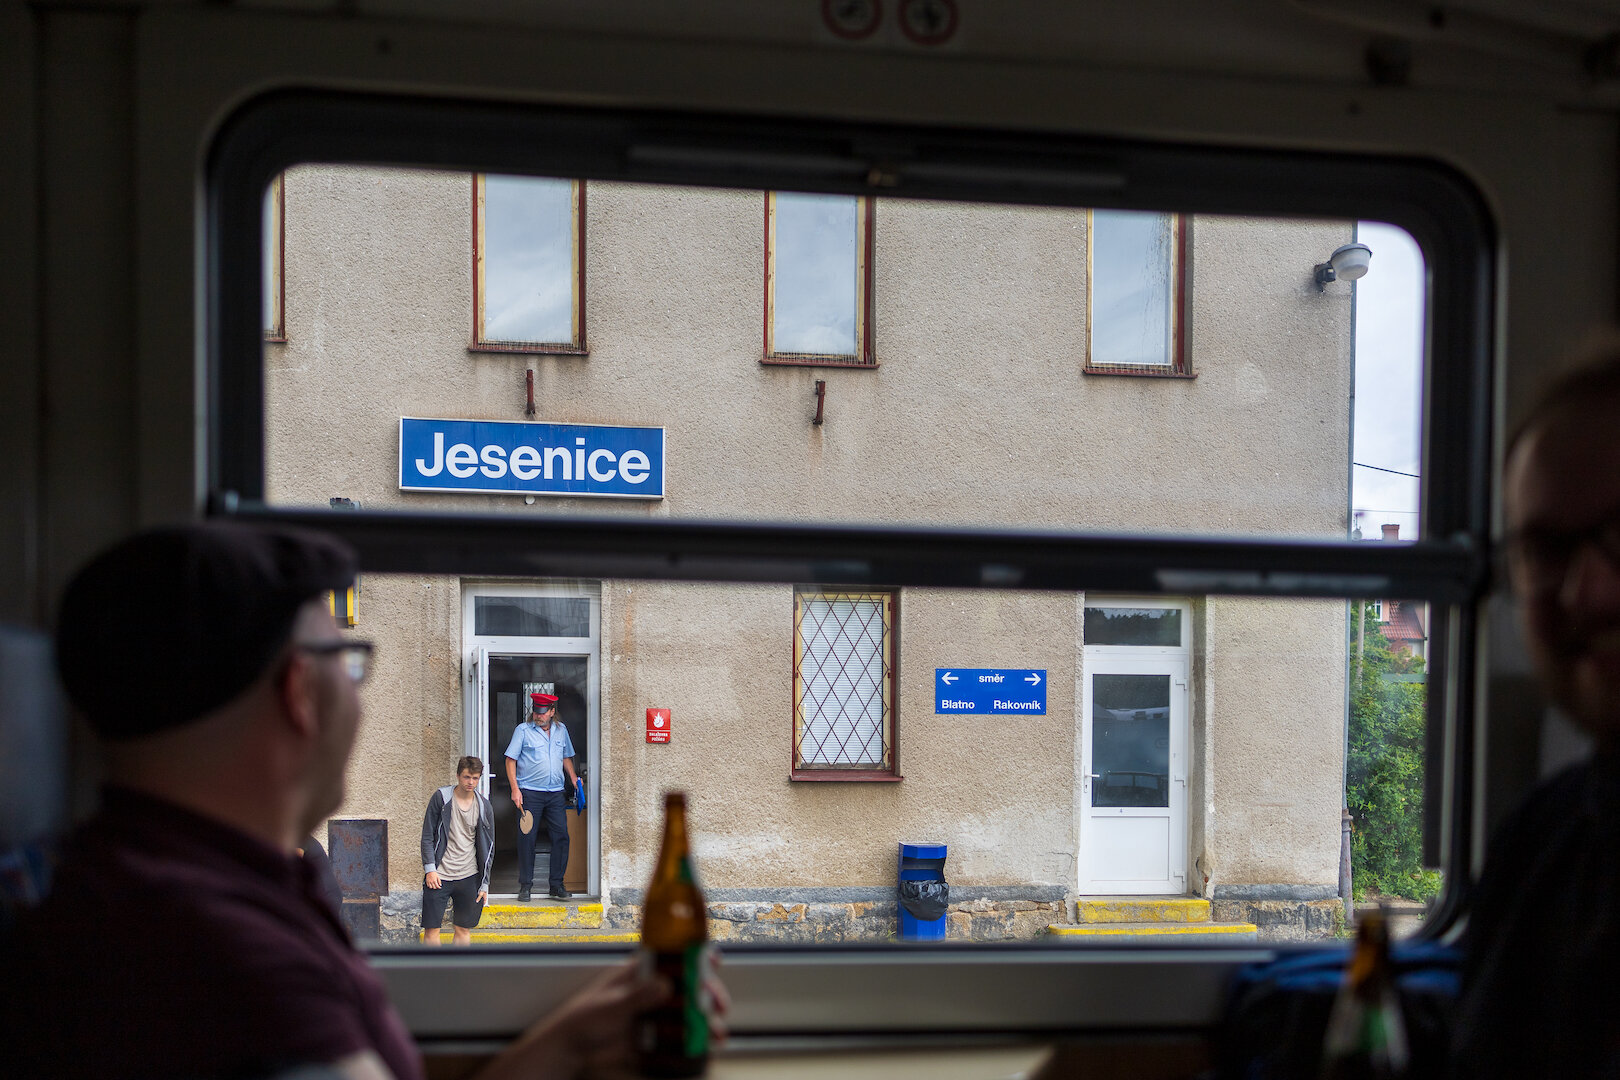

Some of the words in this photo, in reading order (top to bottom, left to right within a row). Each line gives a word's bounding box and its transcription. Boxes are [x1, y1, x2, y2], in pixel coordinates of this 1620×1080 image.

[415, 432, 651, 484] Jesenice
[978, 673, 1005, 683] směr
[941, 699, 975, 709] Blatno
[993, 700, 1041, 710] Rakovník
